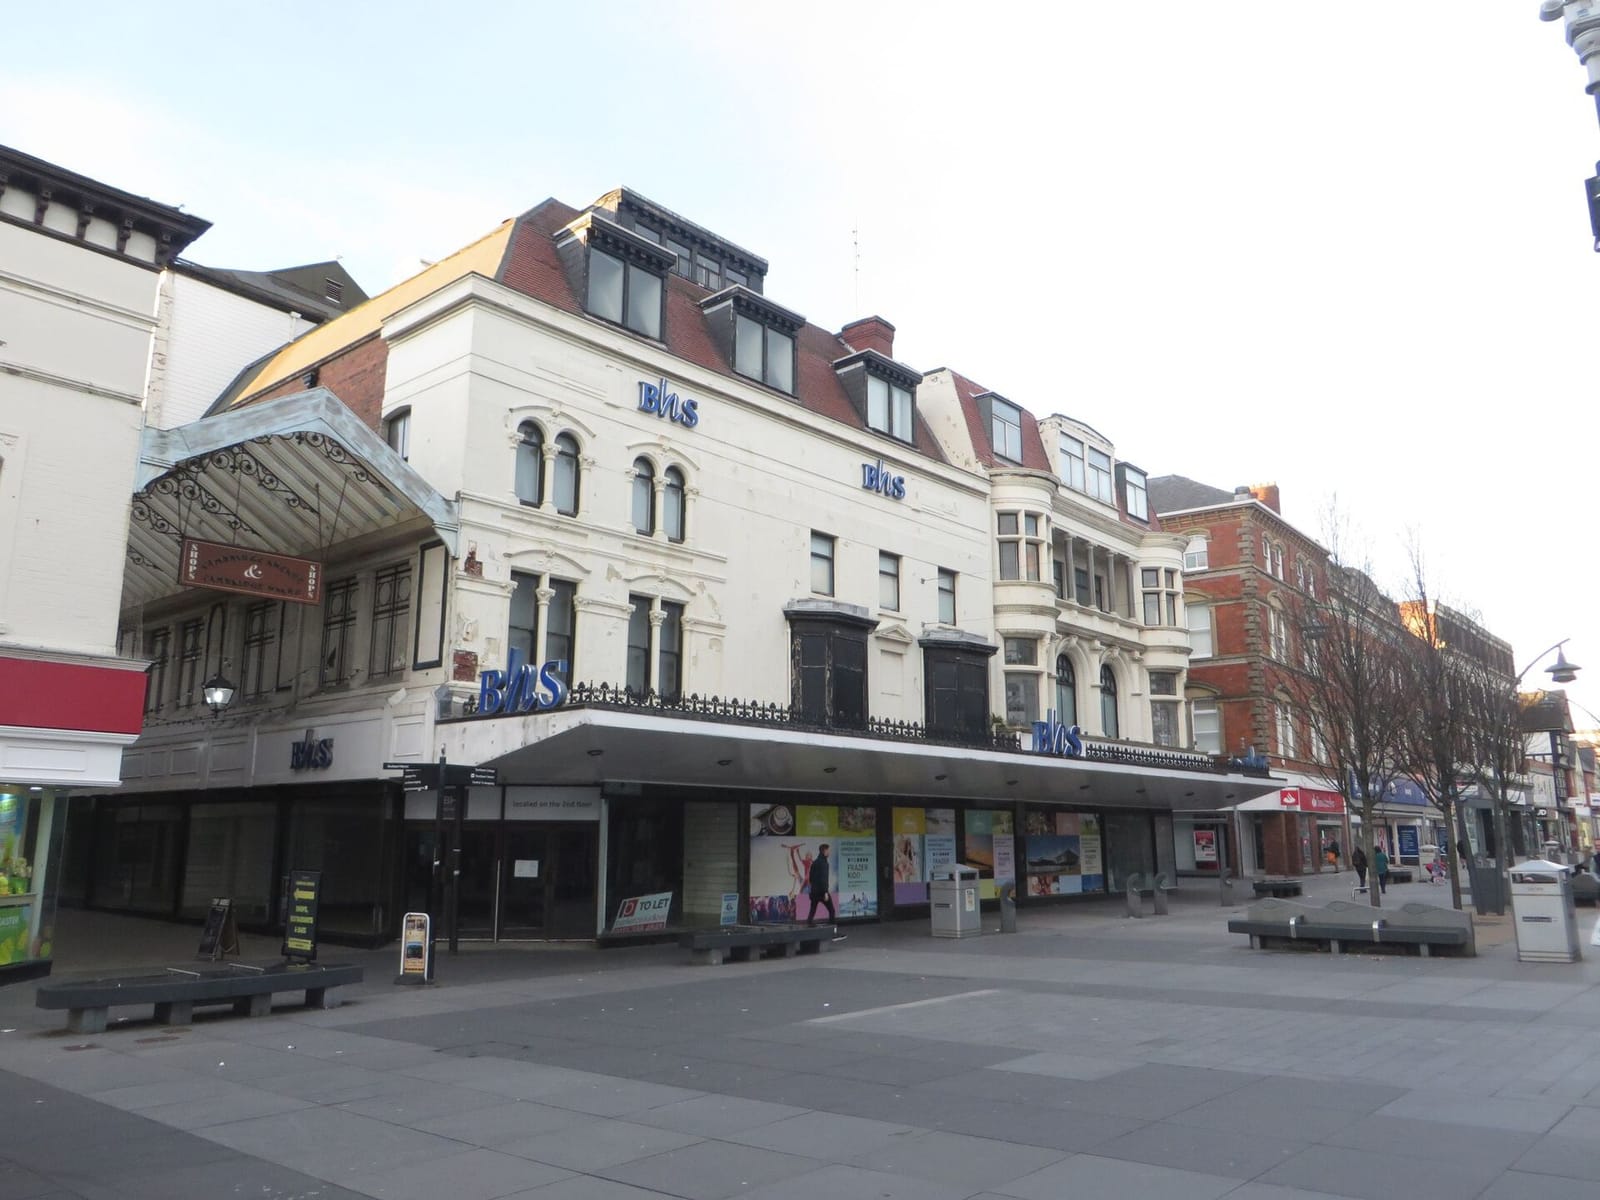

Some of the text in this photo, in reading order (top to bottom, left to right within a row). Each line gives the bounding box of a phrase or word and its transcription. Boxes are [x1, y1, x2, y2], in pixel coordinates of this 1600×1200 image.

[188, 543, 199, 580] SHOPS
[243, 564, 263, 579] &
[307, 564, 317, 599] SHOPS
[512, 800, 538, 809] located
[640, 898, 669, 911] TO LET
